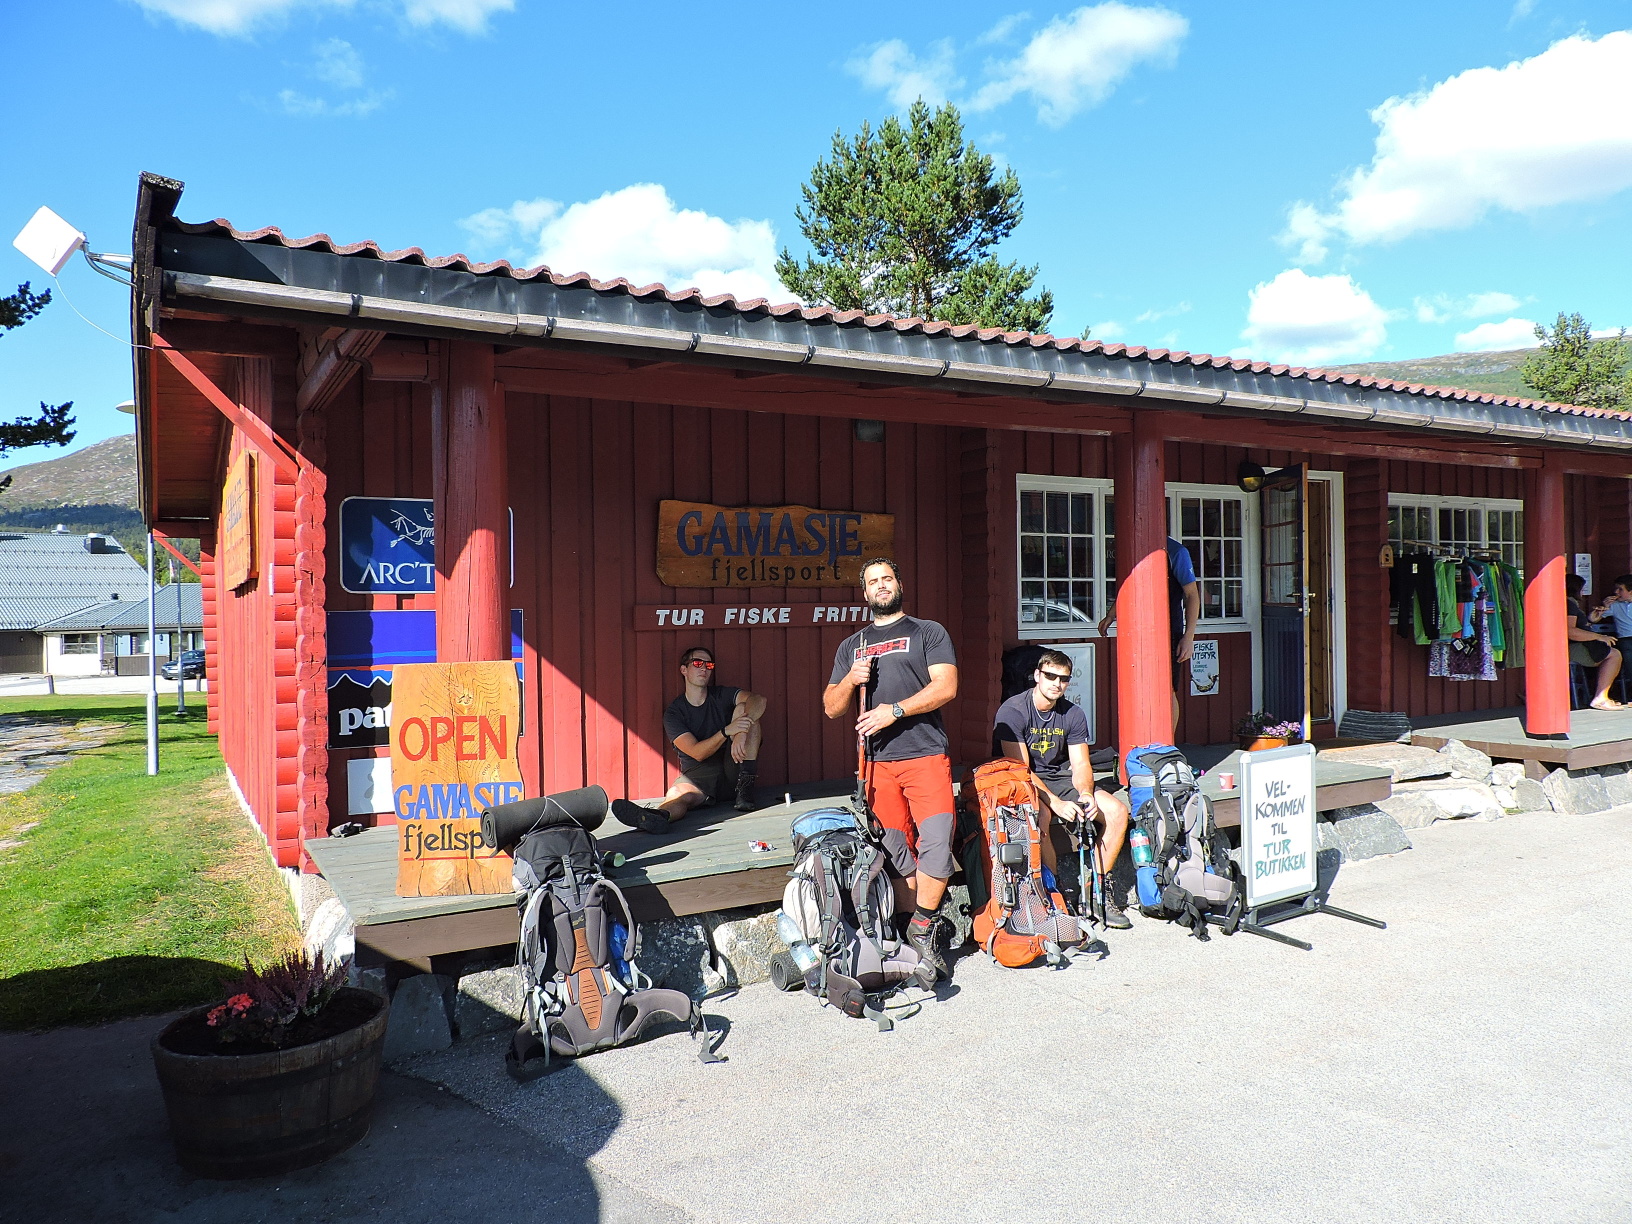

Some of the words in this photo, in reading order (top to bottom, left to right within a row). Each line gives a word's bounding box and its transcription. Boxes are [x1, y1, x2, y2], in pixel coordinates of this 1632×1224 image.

[676, 510, 863, 567] GAMASJE
[710, 557, 842, 587] fjellsport
[655, 609, 705, 626] TUR
[724, 607, 792, 625] FISKE
[1192, 651, 1217, 661] UTSTYR
[1193, 642, 1214, 652] FISKE
[398, 714, 508, 762] OPEN
[1255, 794, 1306, 821] KOMMEN
[403, 823, 497, 860] fjellsp
[1270, 822, 1288, 836] TIL
[1263, 838, 1292, 859] TUR
[1255, 851, 1306, 880] BUTIKKEN
